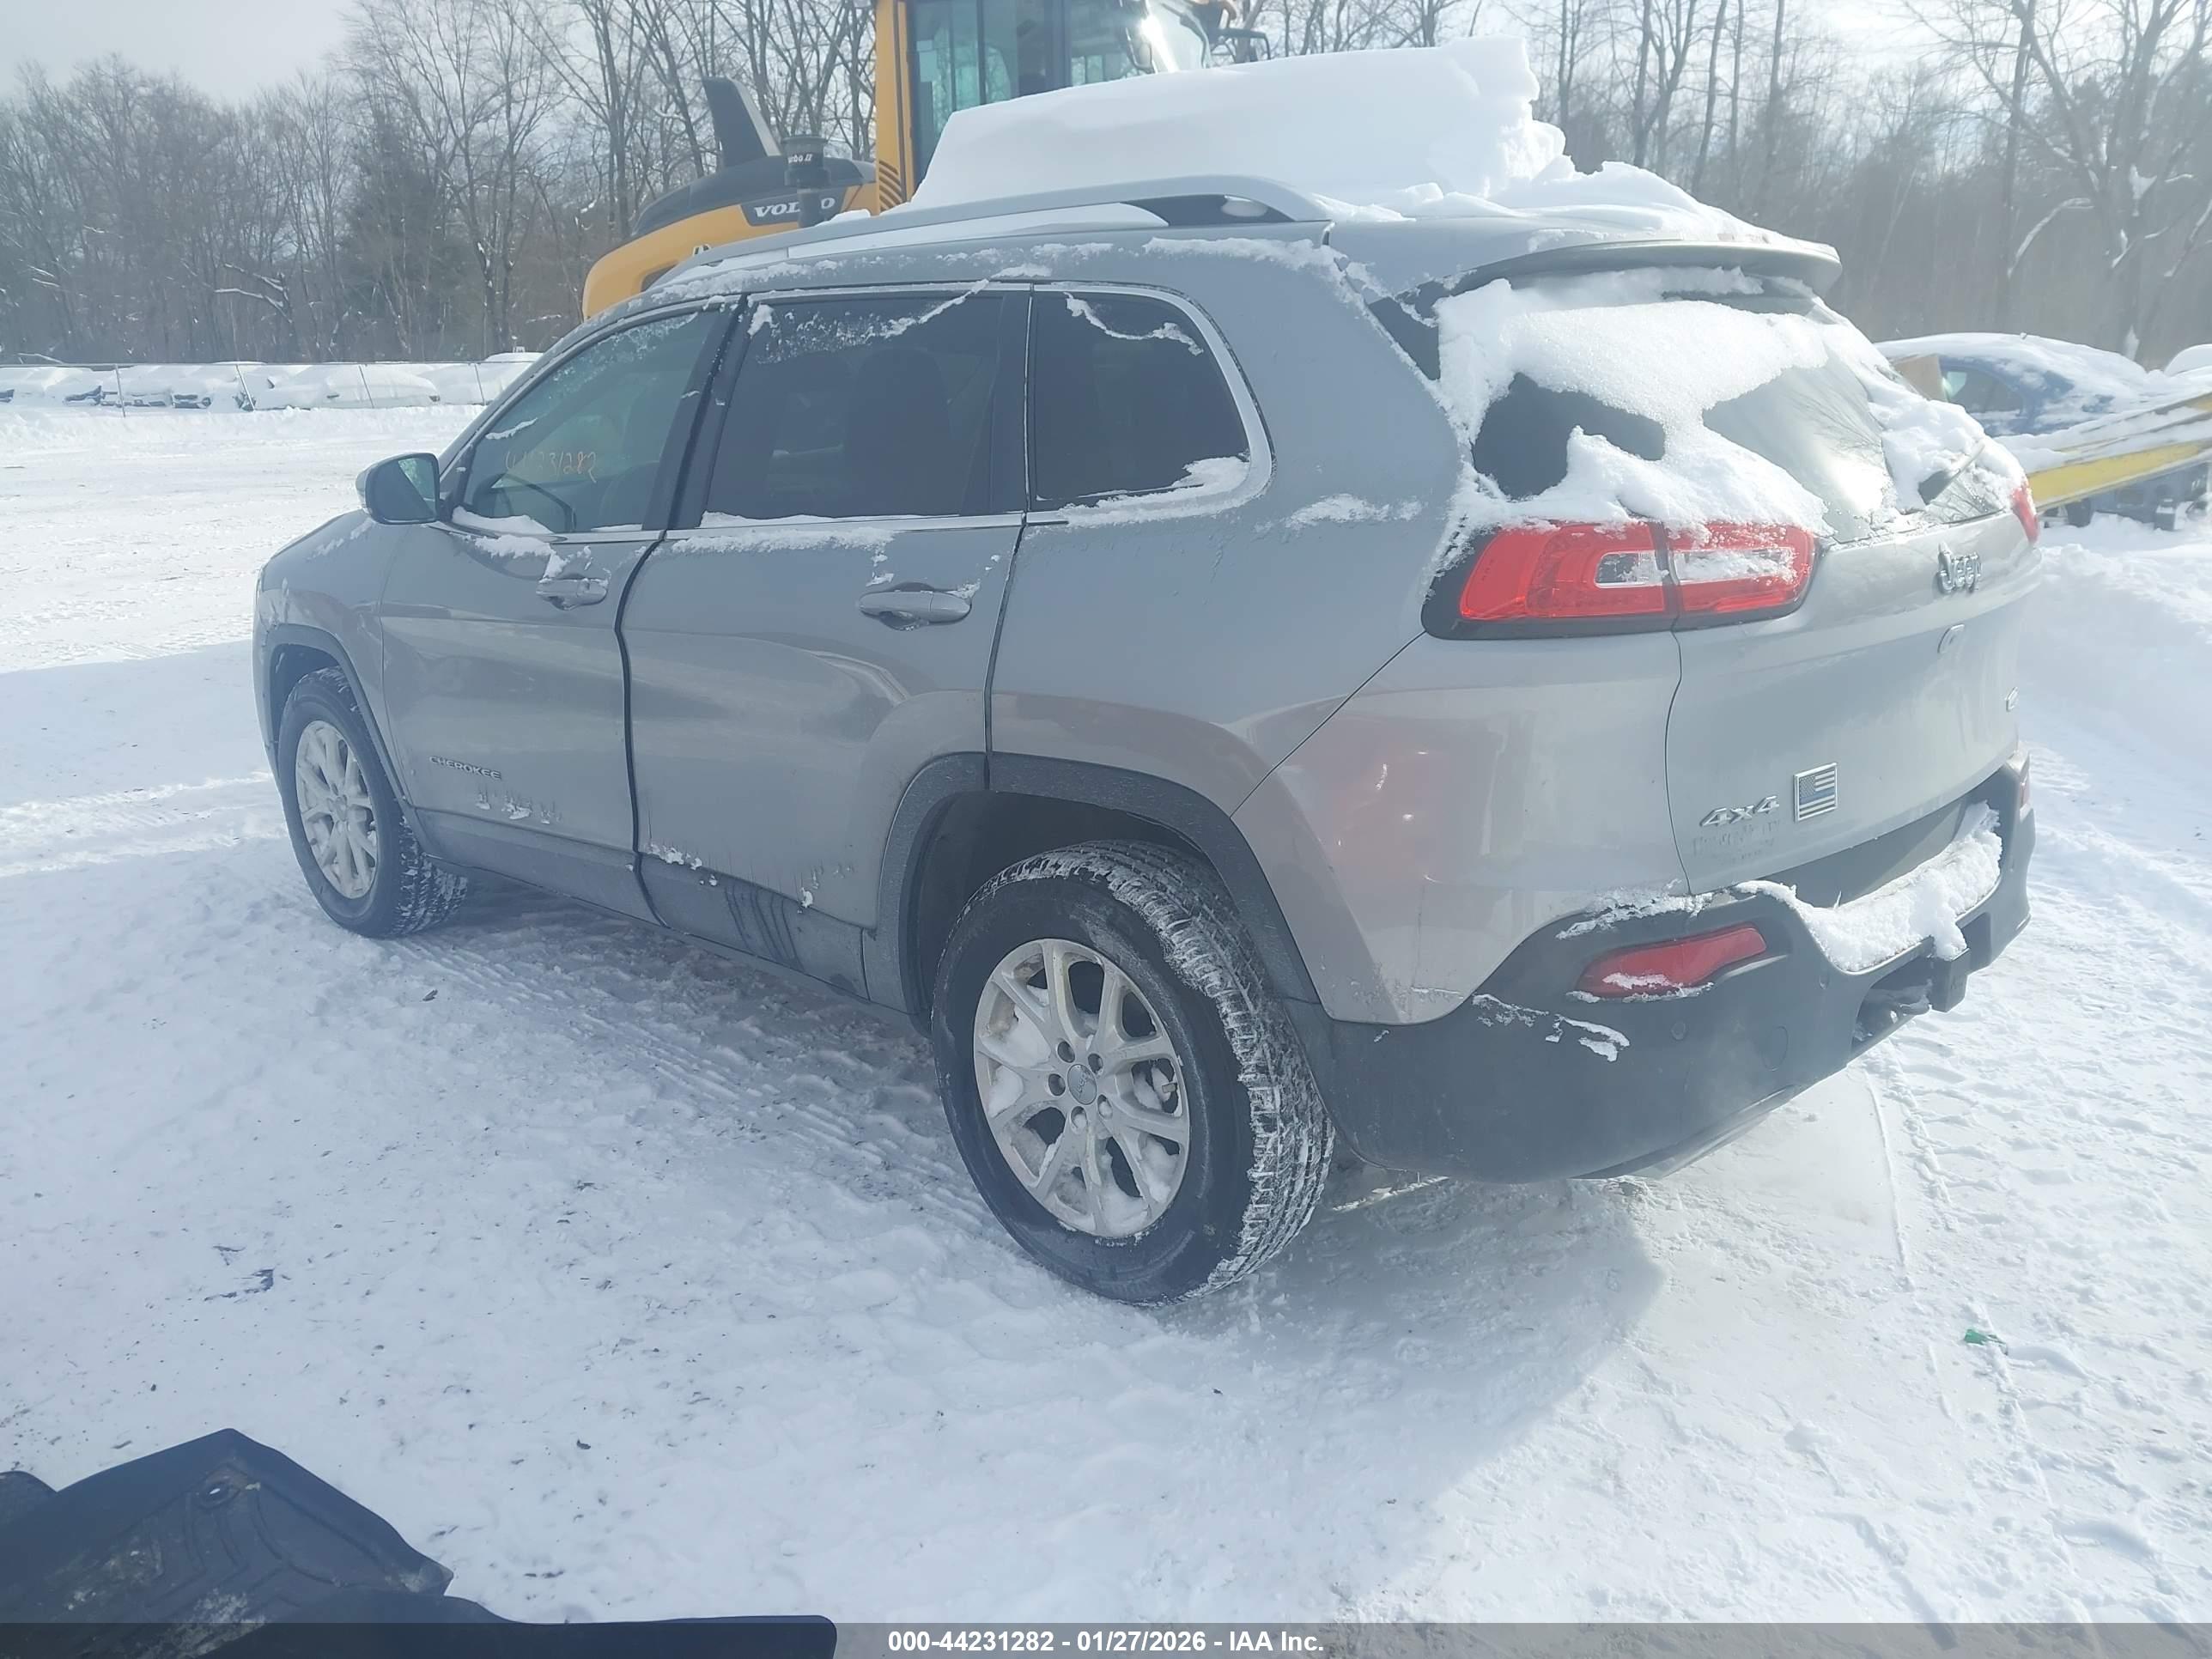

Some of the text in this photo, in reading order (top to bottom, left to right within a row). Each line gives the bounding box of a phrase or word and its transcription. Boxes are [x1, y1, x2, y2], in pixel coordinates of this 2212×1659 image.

[754, 198, 836, 217] VOLO
[1936, 541, 1983, 592] Jeep
[429, 755, 502, 781] CHEROKEE
[1699, 795, 1780, 827] 4x4
